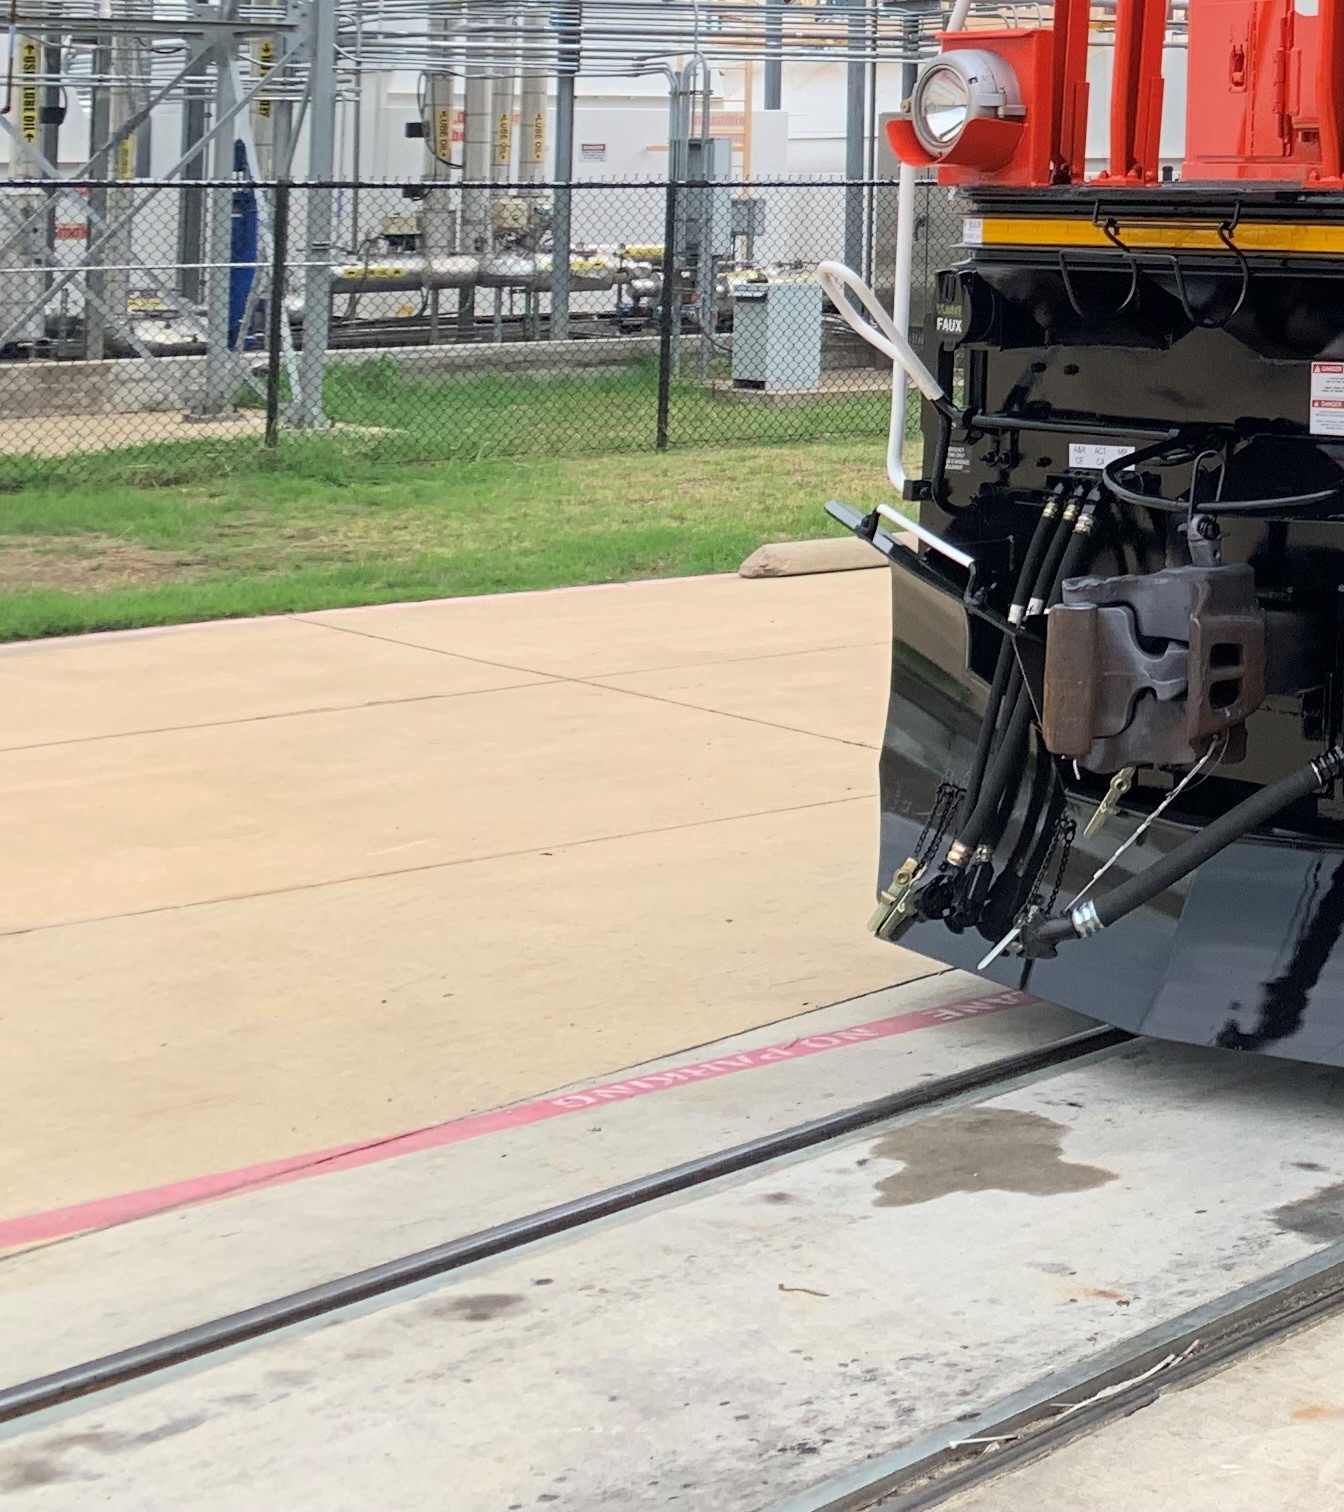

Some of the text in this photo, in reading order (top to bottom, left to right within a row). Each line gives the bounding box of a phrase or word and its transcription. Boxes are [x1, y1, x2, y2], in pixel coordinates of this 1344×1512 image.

[23, 116, 36, 131] OIL
[535, 117, 543, 139] LUBE
[936, 317, 962, 333] FAUX
[799, 1027, 881, 1049] NO
[551, 1046, 796, 1110] PARKING
